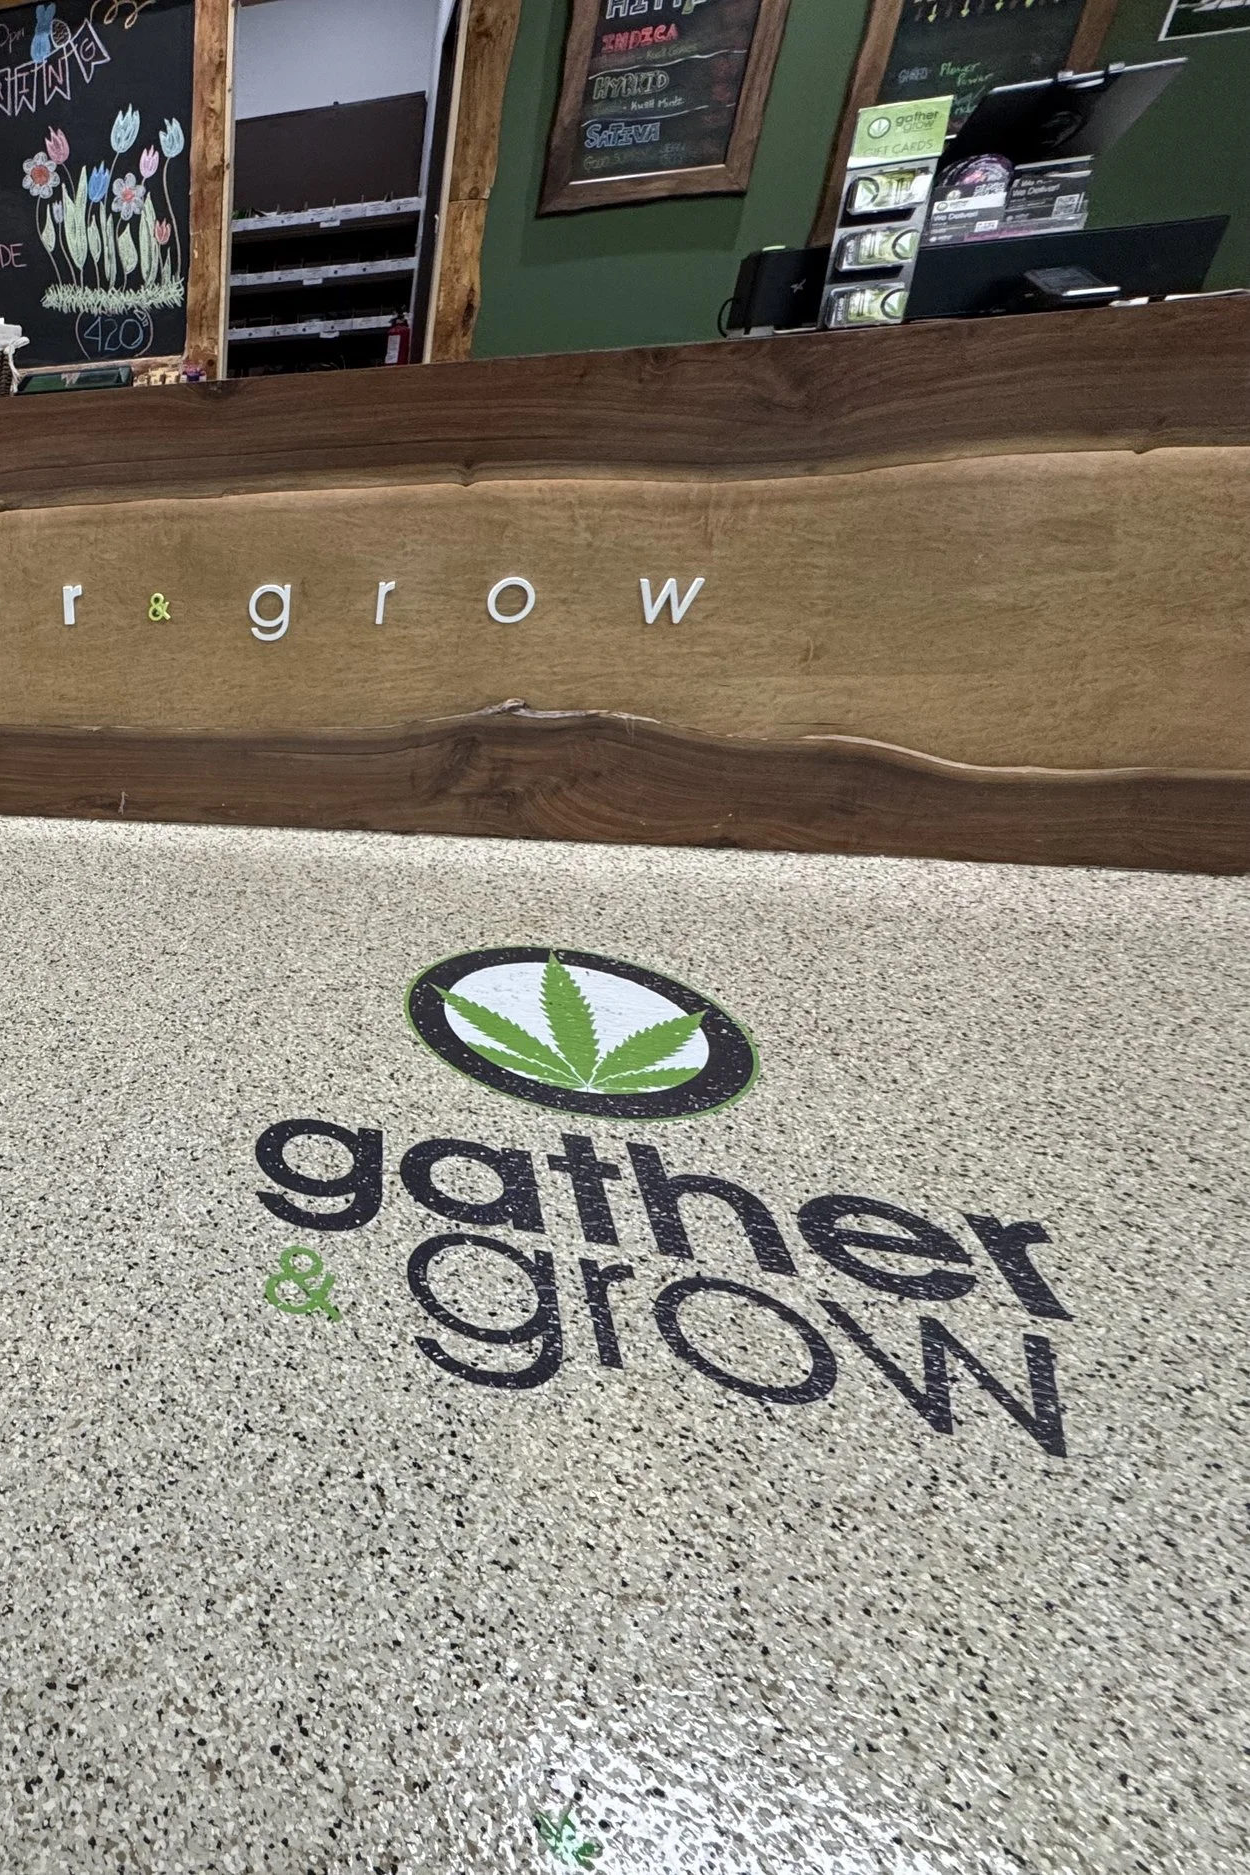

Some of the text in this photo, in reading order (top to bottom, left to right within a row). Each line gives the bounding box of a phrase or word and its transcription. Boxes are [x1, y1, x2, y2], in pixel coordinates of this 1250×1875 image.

[601, 23, 679, 54] INDICA
[896, 111, 939, 127] gather
[892, 140, 934, 155] CARDS
[148, 592, 171, 621] &
[248, 575, 706, 642] grow
[255, 1118, 1074, 1322] gather
[265, 1232, 1068, 1459] & grow
